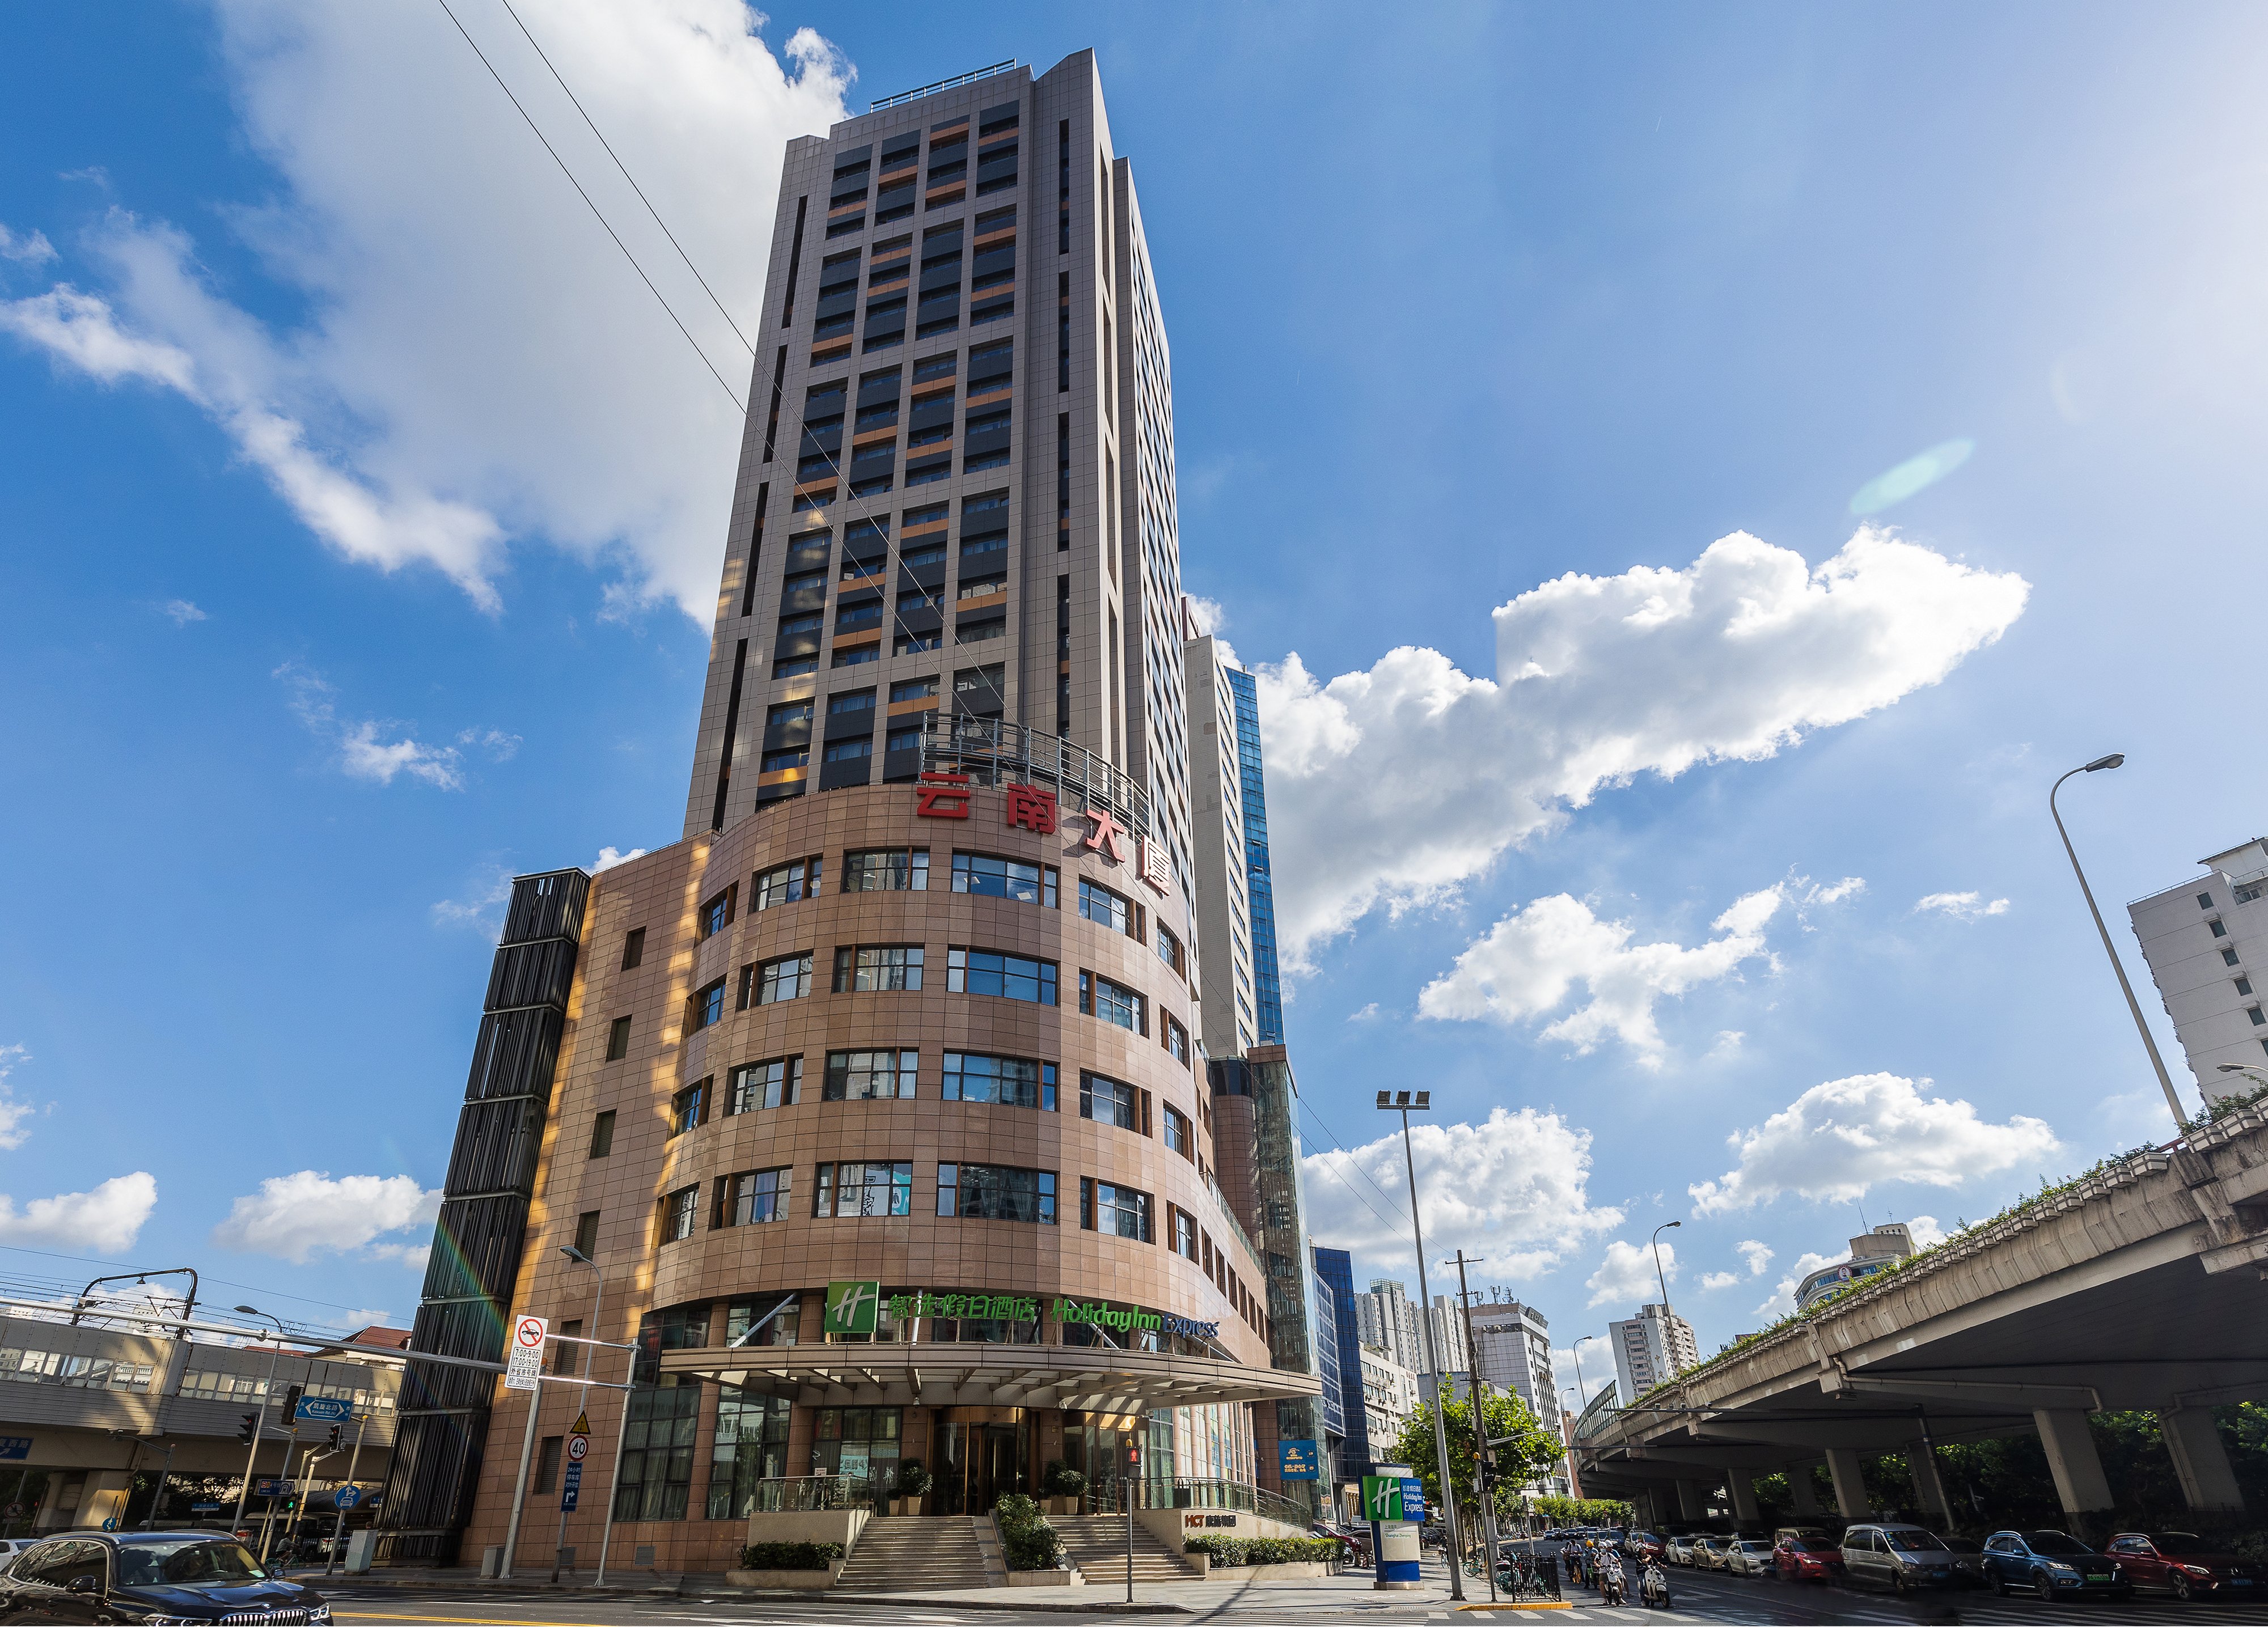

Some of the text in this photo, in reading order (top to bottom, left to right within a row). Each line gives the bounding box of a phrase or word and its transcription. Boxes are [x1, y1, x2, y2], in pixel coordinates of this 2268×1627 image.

[917, 772, 1170, 896] 云南大厦
[888, 1293, 1038, 1322] 智选假日酒店
[1162, 1312, 1220, 1338] Express
[515, 1349, 539, 1359] 7:00-9:00
[513, 1357, 538, 1367] 17:00-19:00
[511, 1367, 536, 1377] 外省市号牌
[313, 1403, 338, 1411] 凯旋北路
[572, 1442, 585, 1454] 40
[1404, 1501, 1423, 1514] Express
